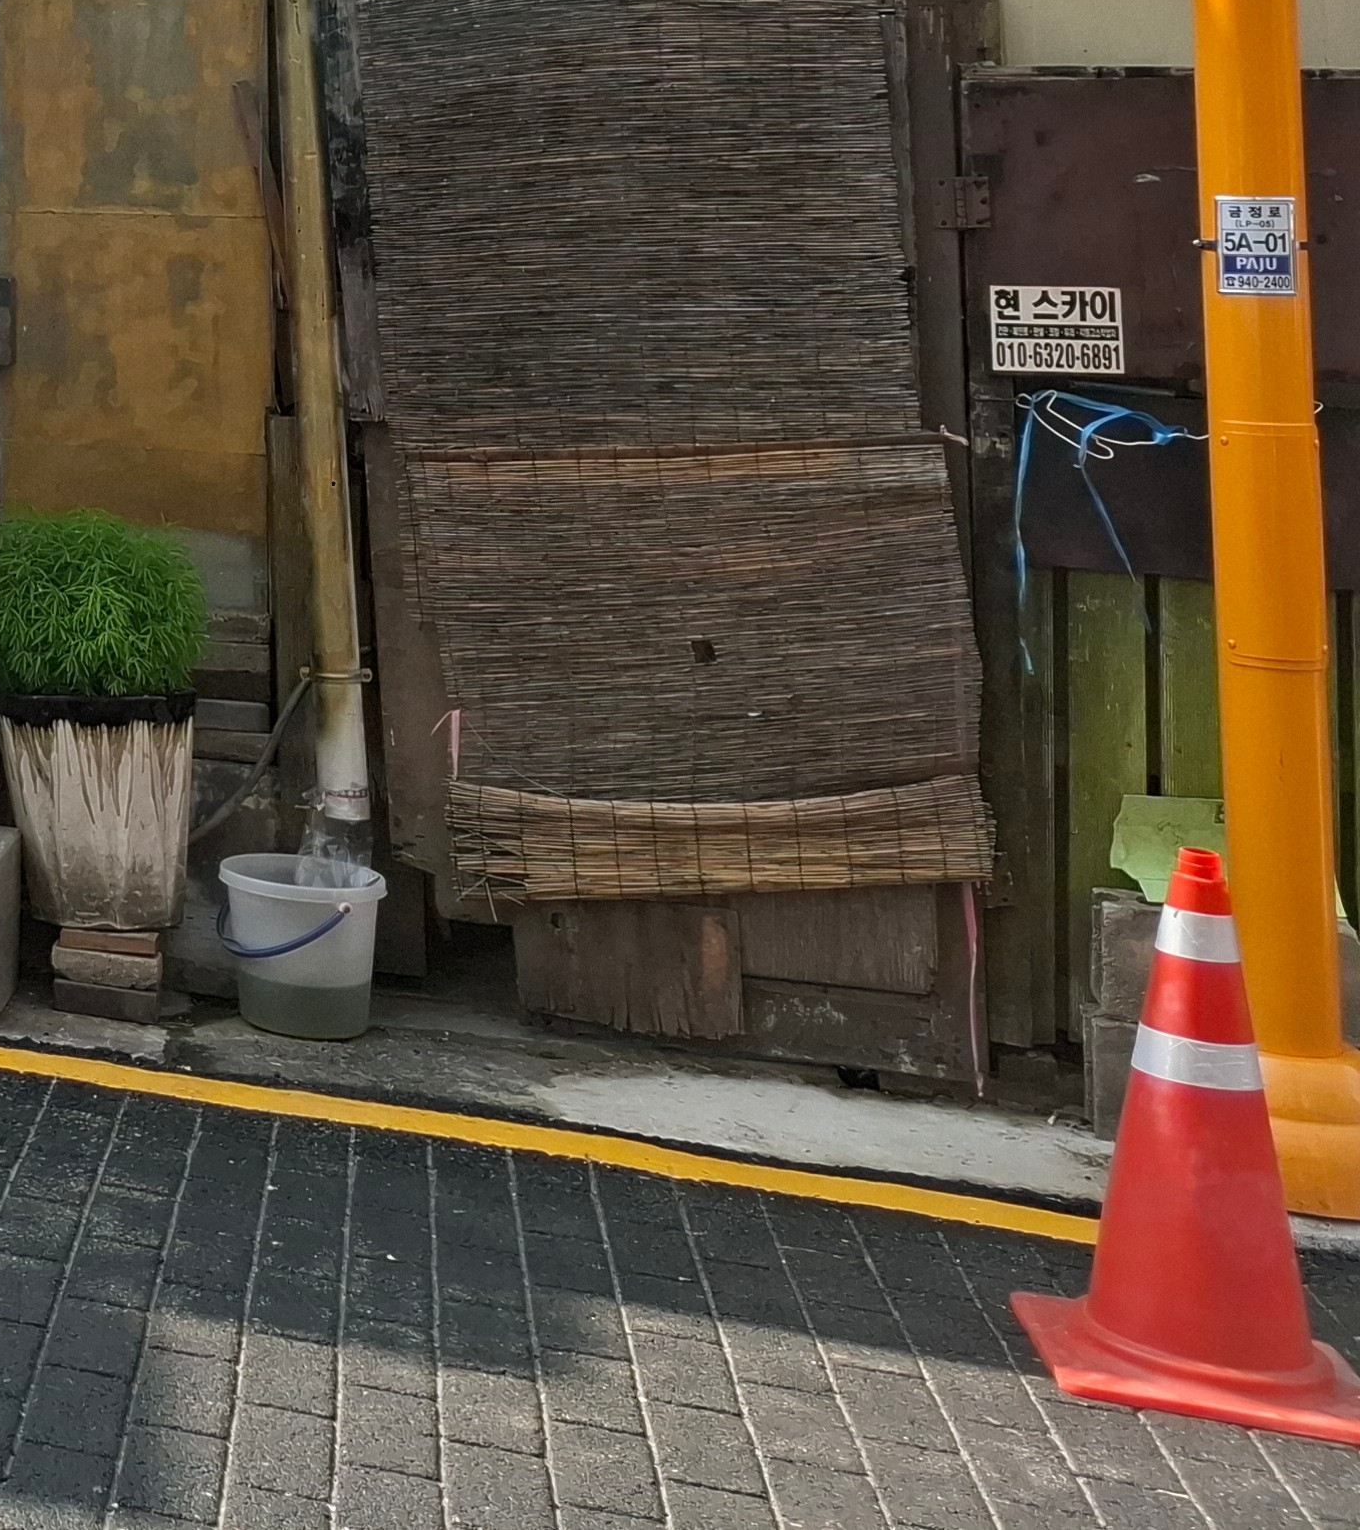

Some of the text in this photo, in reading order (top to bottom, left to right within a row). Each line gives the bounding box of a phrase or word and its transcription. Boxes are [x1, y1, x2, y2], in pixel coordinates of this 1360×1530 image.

[1228, 205, 1282, 219] 금정로
[1224, 232, 1287, 253] 5A-01
[1236, 257, 1278, 272] PAJU
[1237, 276, 1291, 288] 940-2400
[994, 288, 1118, 323] 현 스카이
